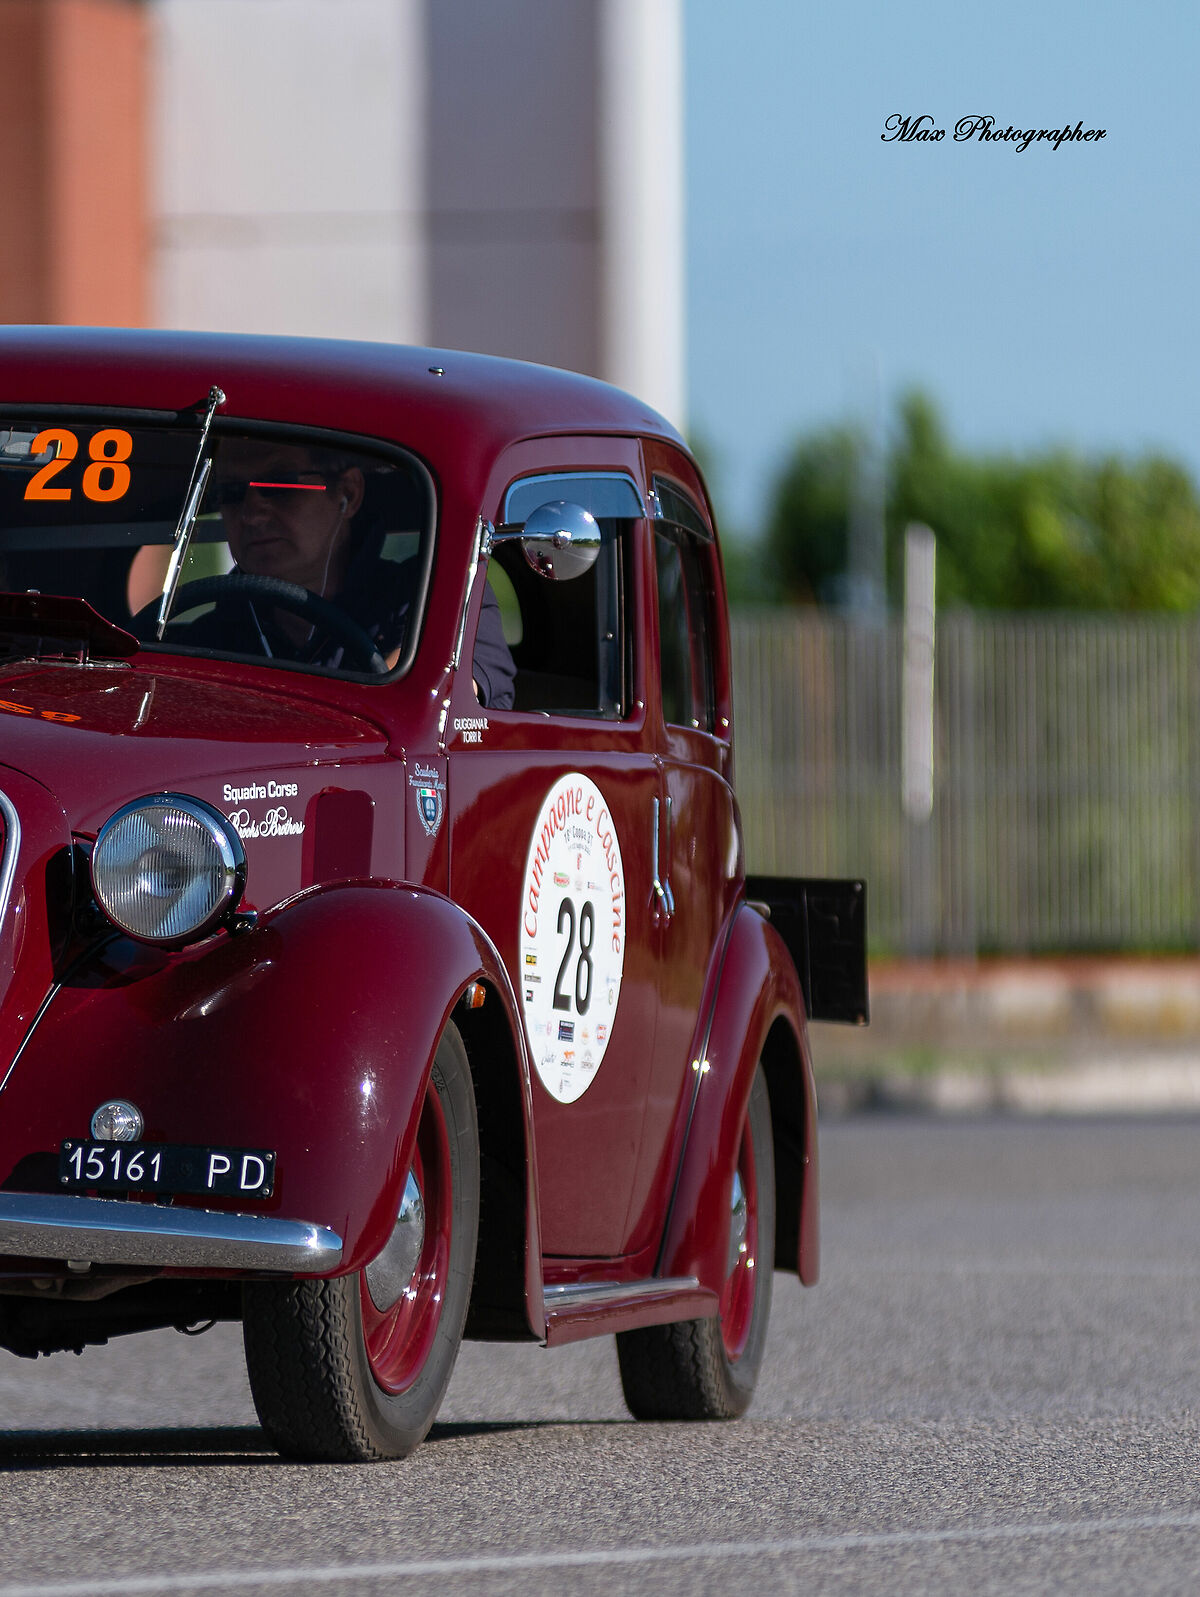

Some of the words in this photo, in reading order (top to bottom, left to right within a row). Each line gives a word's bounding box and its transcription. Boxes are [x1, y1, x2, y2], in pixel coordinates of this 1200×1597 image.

[23, 428, 133, 502] 28
[223, 782, 267, 805] Squadra
[267, 780, 299, 799] Corse
[259, 806, 306, 838] Brothers
[523, 786, 583, 939] Campagne
[586, 794, 596, 822] e
[596, 808, 624, 955] Cascine
[552, 896, 596, 1017] 28
[68, 1147, 162, 1182] 15161
